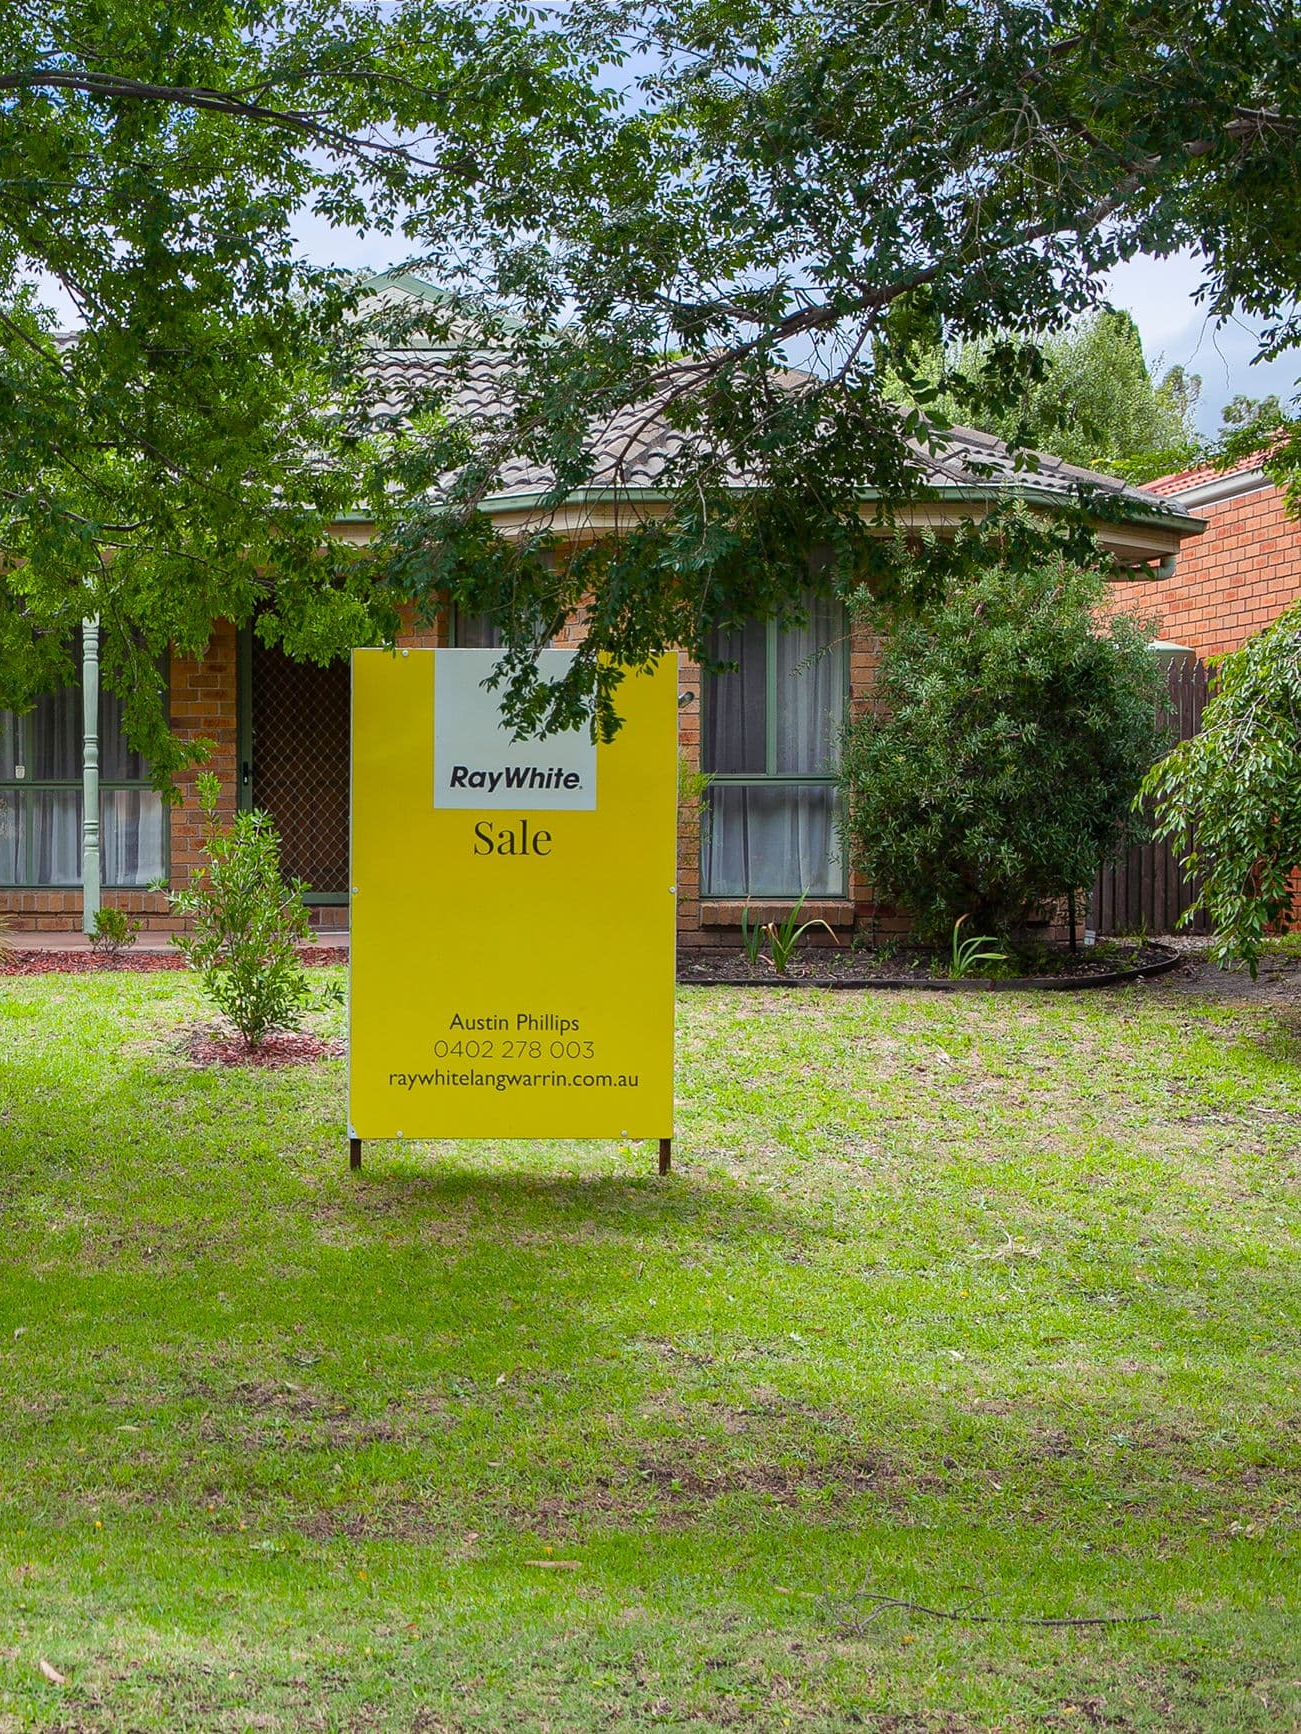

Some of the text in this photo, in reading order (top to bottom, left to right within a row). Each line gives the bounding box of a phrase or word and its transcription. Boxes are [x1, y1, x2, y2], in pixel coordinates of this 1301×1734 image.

[474, 819, 552, 856] Sale
[450, 1013, 579, 1036] Austin Phillips
[434, 1040, 595, 1059] 0402 278 003
[389, 1069, 639, 1091] raywhitelangwarrin.com.au
